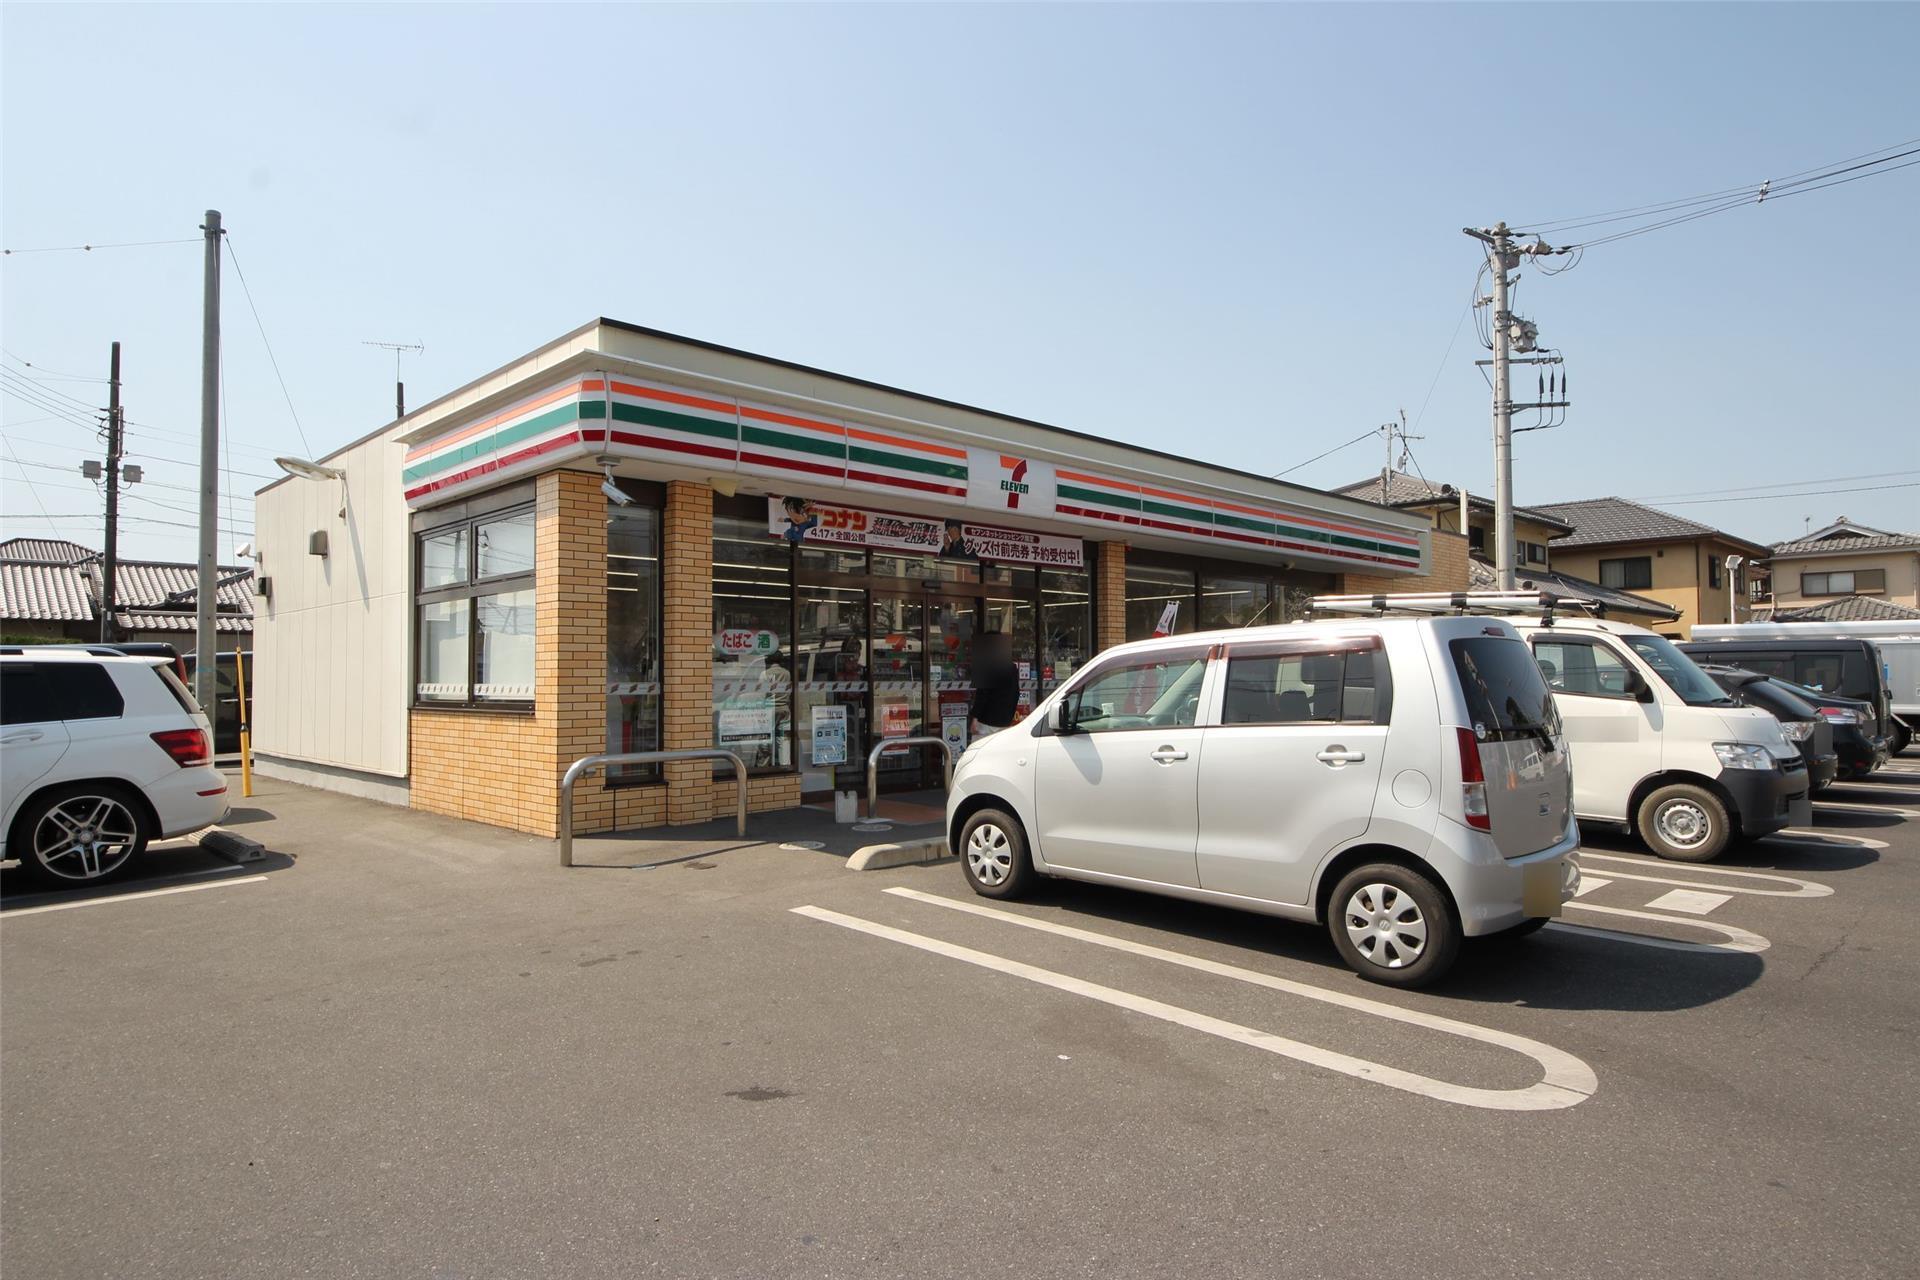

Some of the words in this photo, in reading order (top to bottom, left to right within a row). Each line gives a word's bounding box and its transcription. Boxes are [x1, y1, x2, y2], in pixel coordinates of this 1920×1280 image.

[965, 538, 1030, 560] グッズ付前売券
[721, 632, 753, 648] たばこ
[757, 634, 771, 648] 酒
